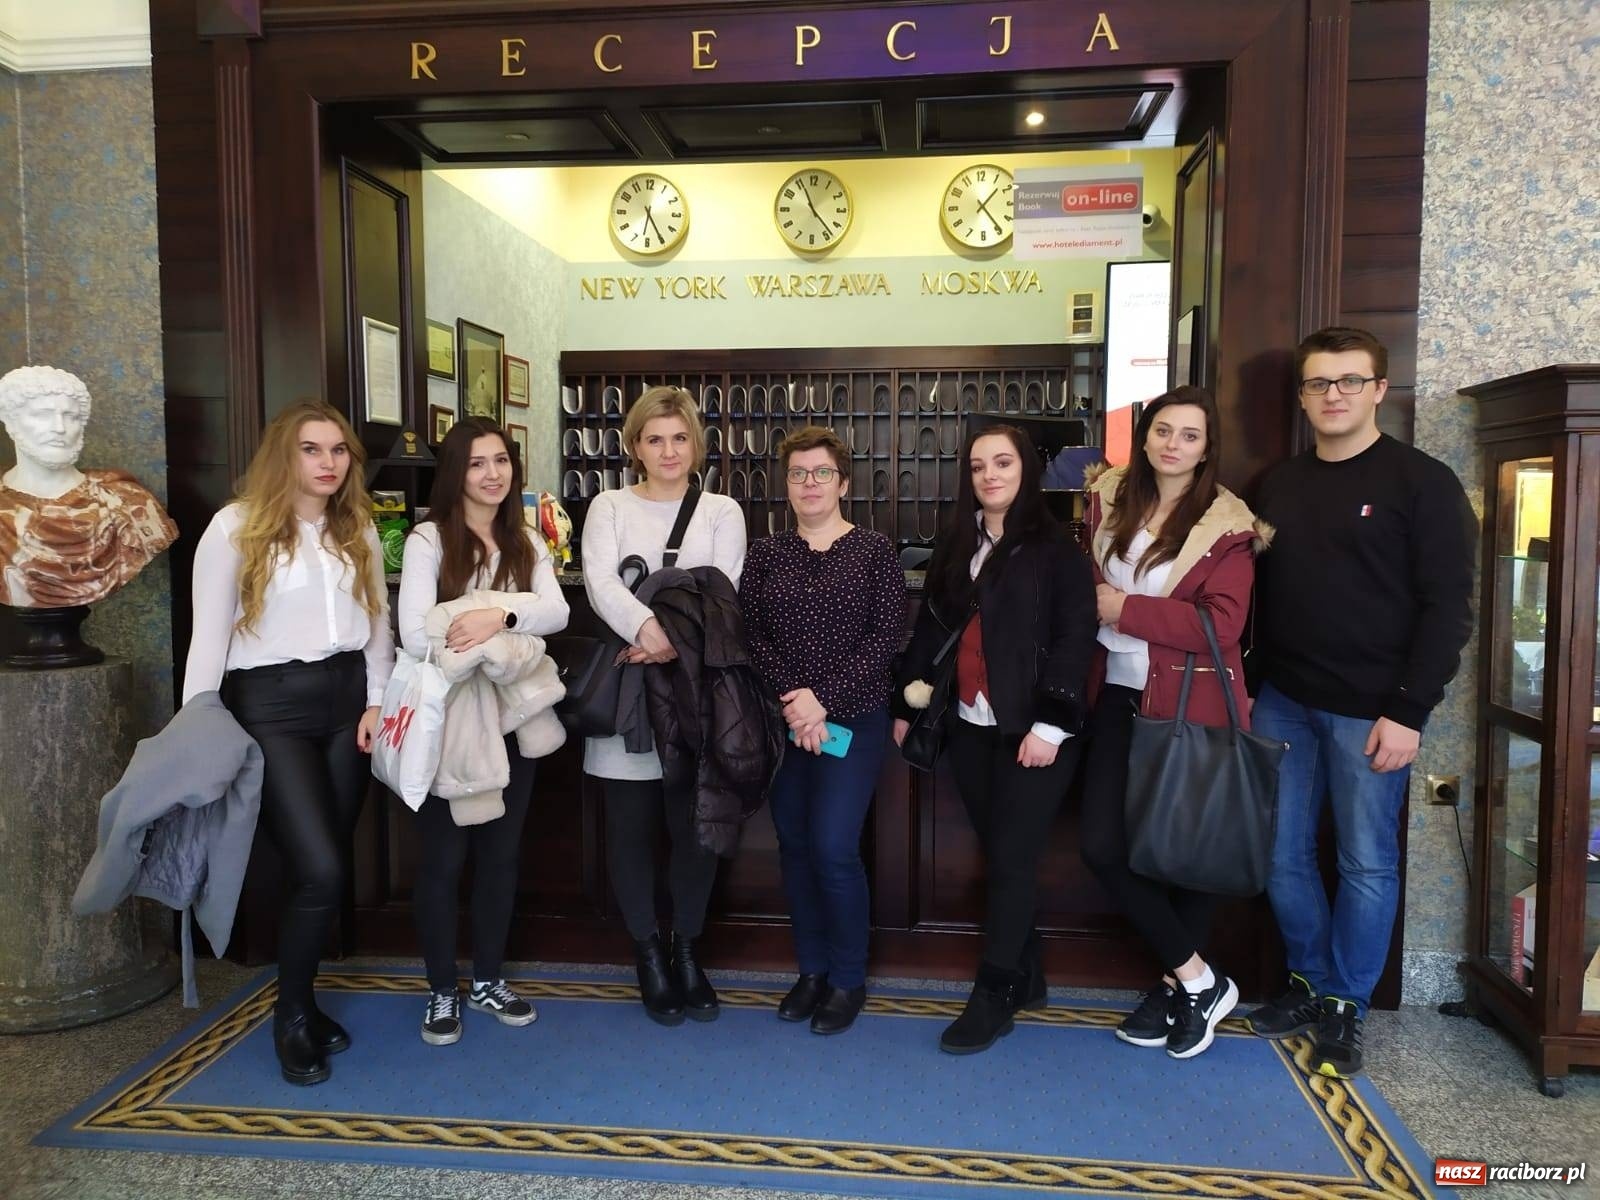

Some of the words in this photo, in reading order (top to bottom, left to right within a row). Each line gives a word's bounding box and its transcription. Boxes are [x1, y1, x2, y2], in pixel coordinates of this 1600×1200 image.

[410, 13, 1120, 80] RECEPCJA
[810, 175, 819, 186] 12
[962, 175, 972, 187] 11
[976, 170, 986, 182] 12
[993, 174, 1000, 184] 1
[632, 181, 641, 194] 11
[646, 179, 655, 190] 12
[661, 185, 667, 194] 1
[825, 180, 832, 190] 1
[1002, 184, 1013, 194] 2
[621, 191, 632, 203] 10
[784, 188, 795, 200] 10
[833, 191, 843, 200] 2
[951, 187, 963, 198] 10
[1018, 190, 1060, 201] Rezerwuj
[1066, 188, 1134, 206] on-line
[668, 197, 679, 205] 2
[1018, 202, 1041, 211] Book
[668, 225, 677, 233] 4
[966, 228, 973, 238] 7
[630, 233, 639, 242] 7
[795, 230, 803, 240] 7
[822, 230, 831, 241] 5
[1032, 238, 1123, 249] www.hotelediament.pl
[580, 276, 645, 300] NEW
[653, 275, 727, 300] YORK
[744, 272, 892, 298] WARSZAWA
[920, 269, 1043, 295] MOSKWA
